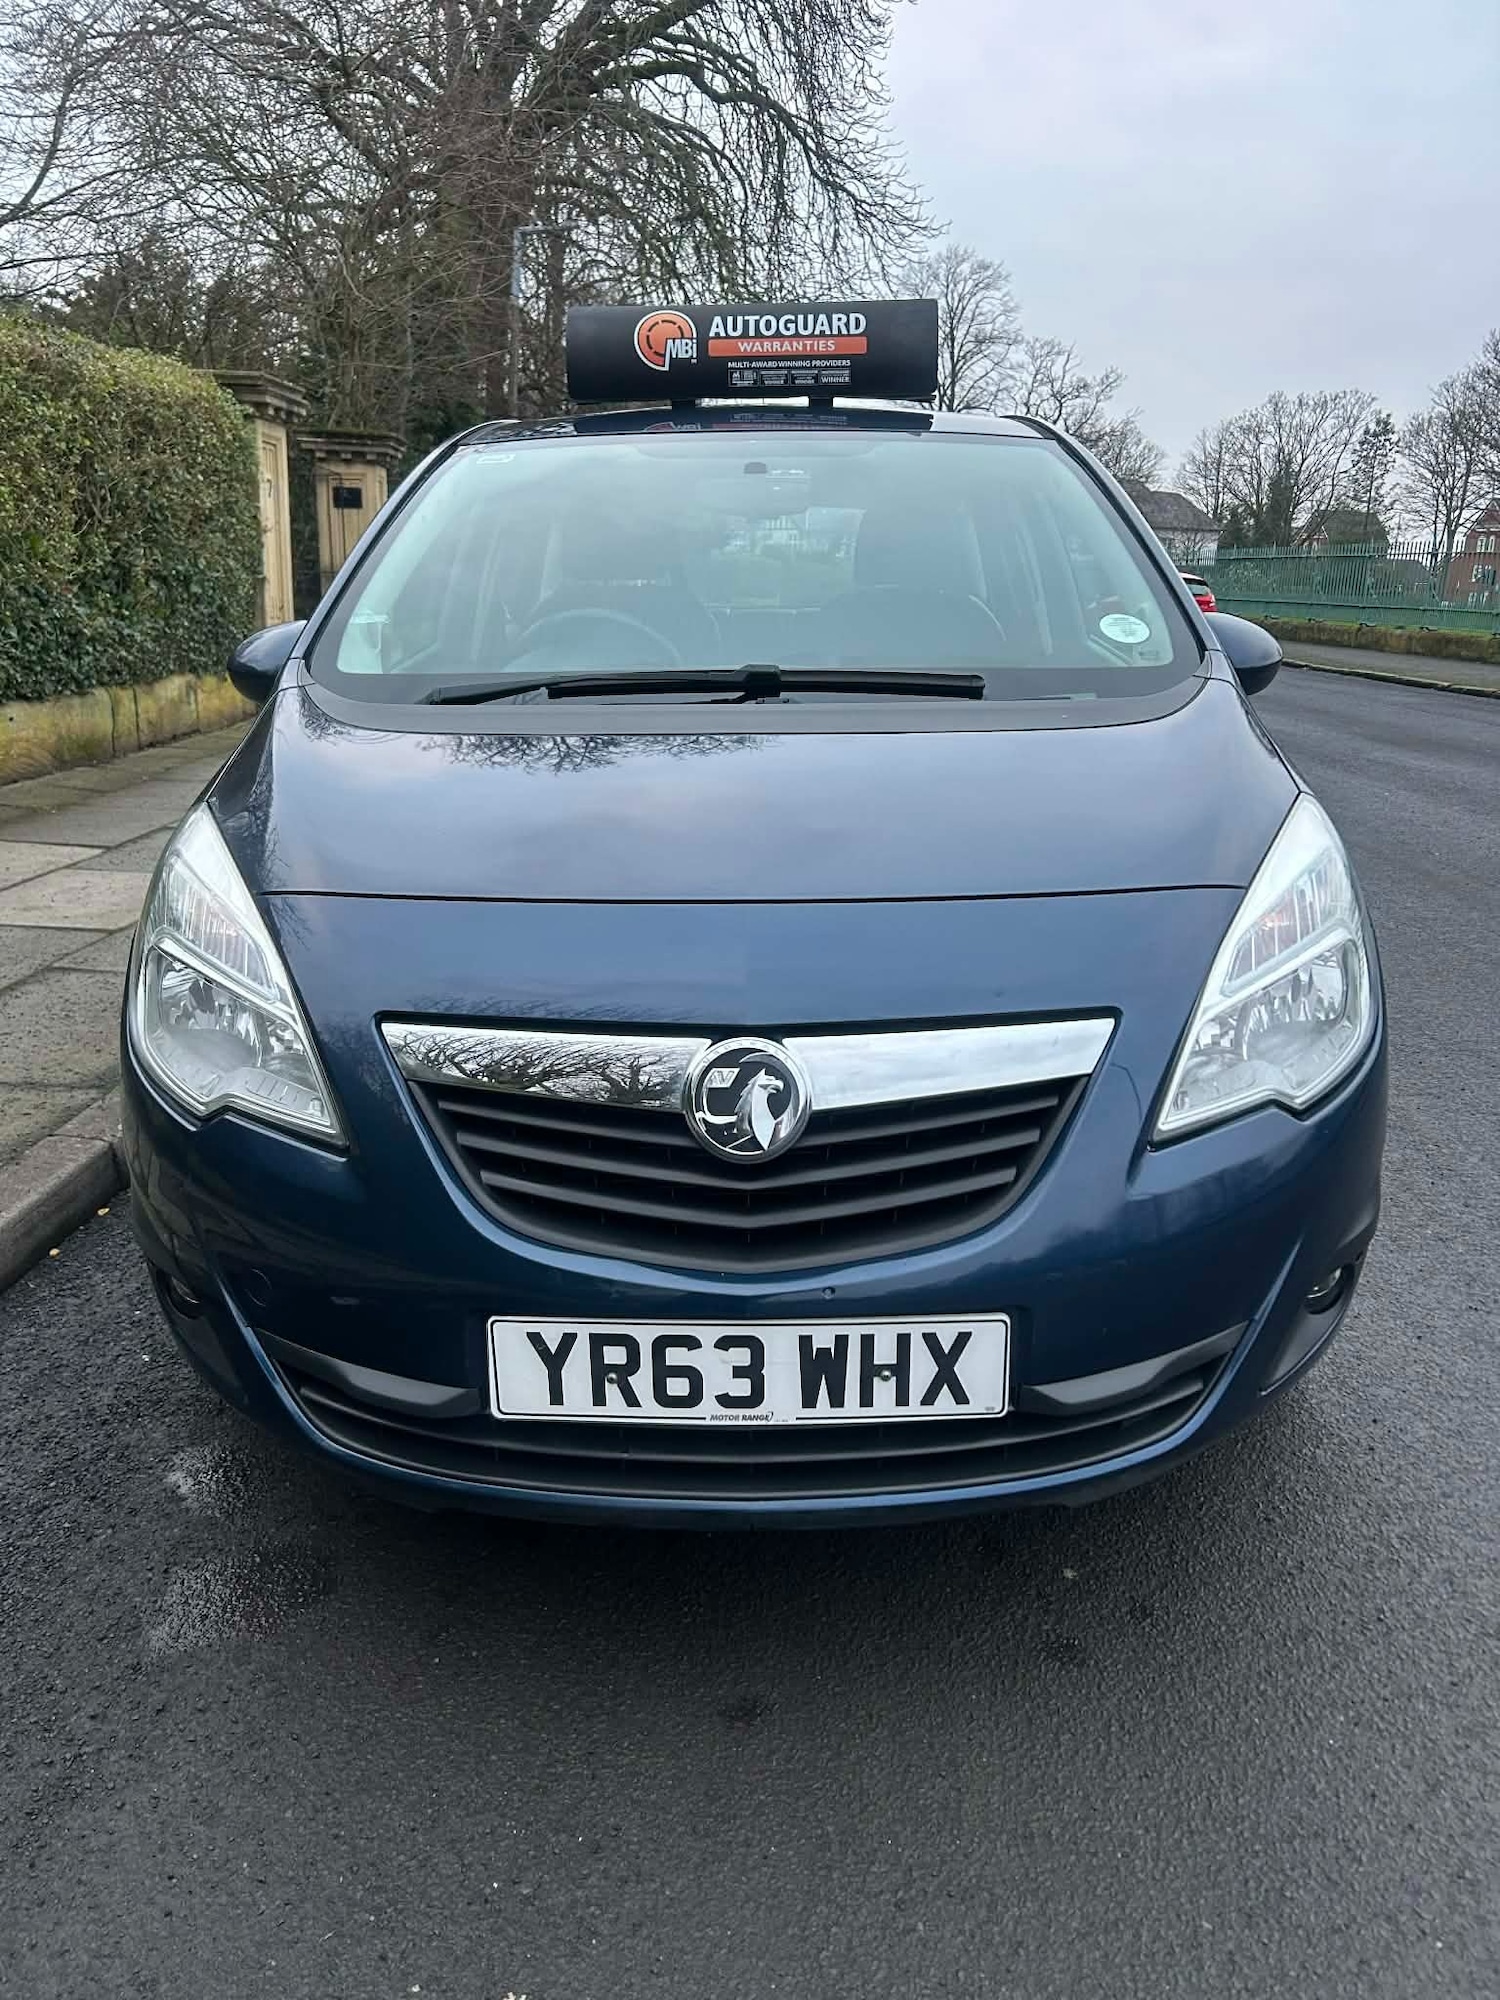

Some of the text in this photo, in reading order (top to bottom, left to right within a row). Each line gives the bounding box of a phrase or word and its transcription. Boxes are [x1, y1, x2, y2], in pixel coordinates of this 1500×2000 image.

[709, 313, 867, 337] AUTOGUARD
[737, 339, 836, 354] WARRANTIES
[811, 359, 851, 367] PROVIDERS
[821, 376, 850, 384] WINNER
[526, 1331, 973, 1409] YR63 WHX
[710, 1414, 739, 1422] MOTOR
[741, 1413, 770, 1422] RANGE
